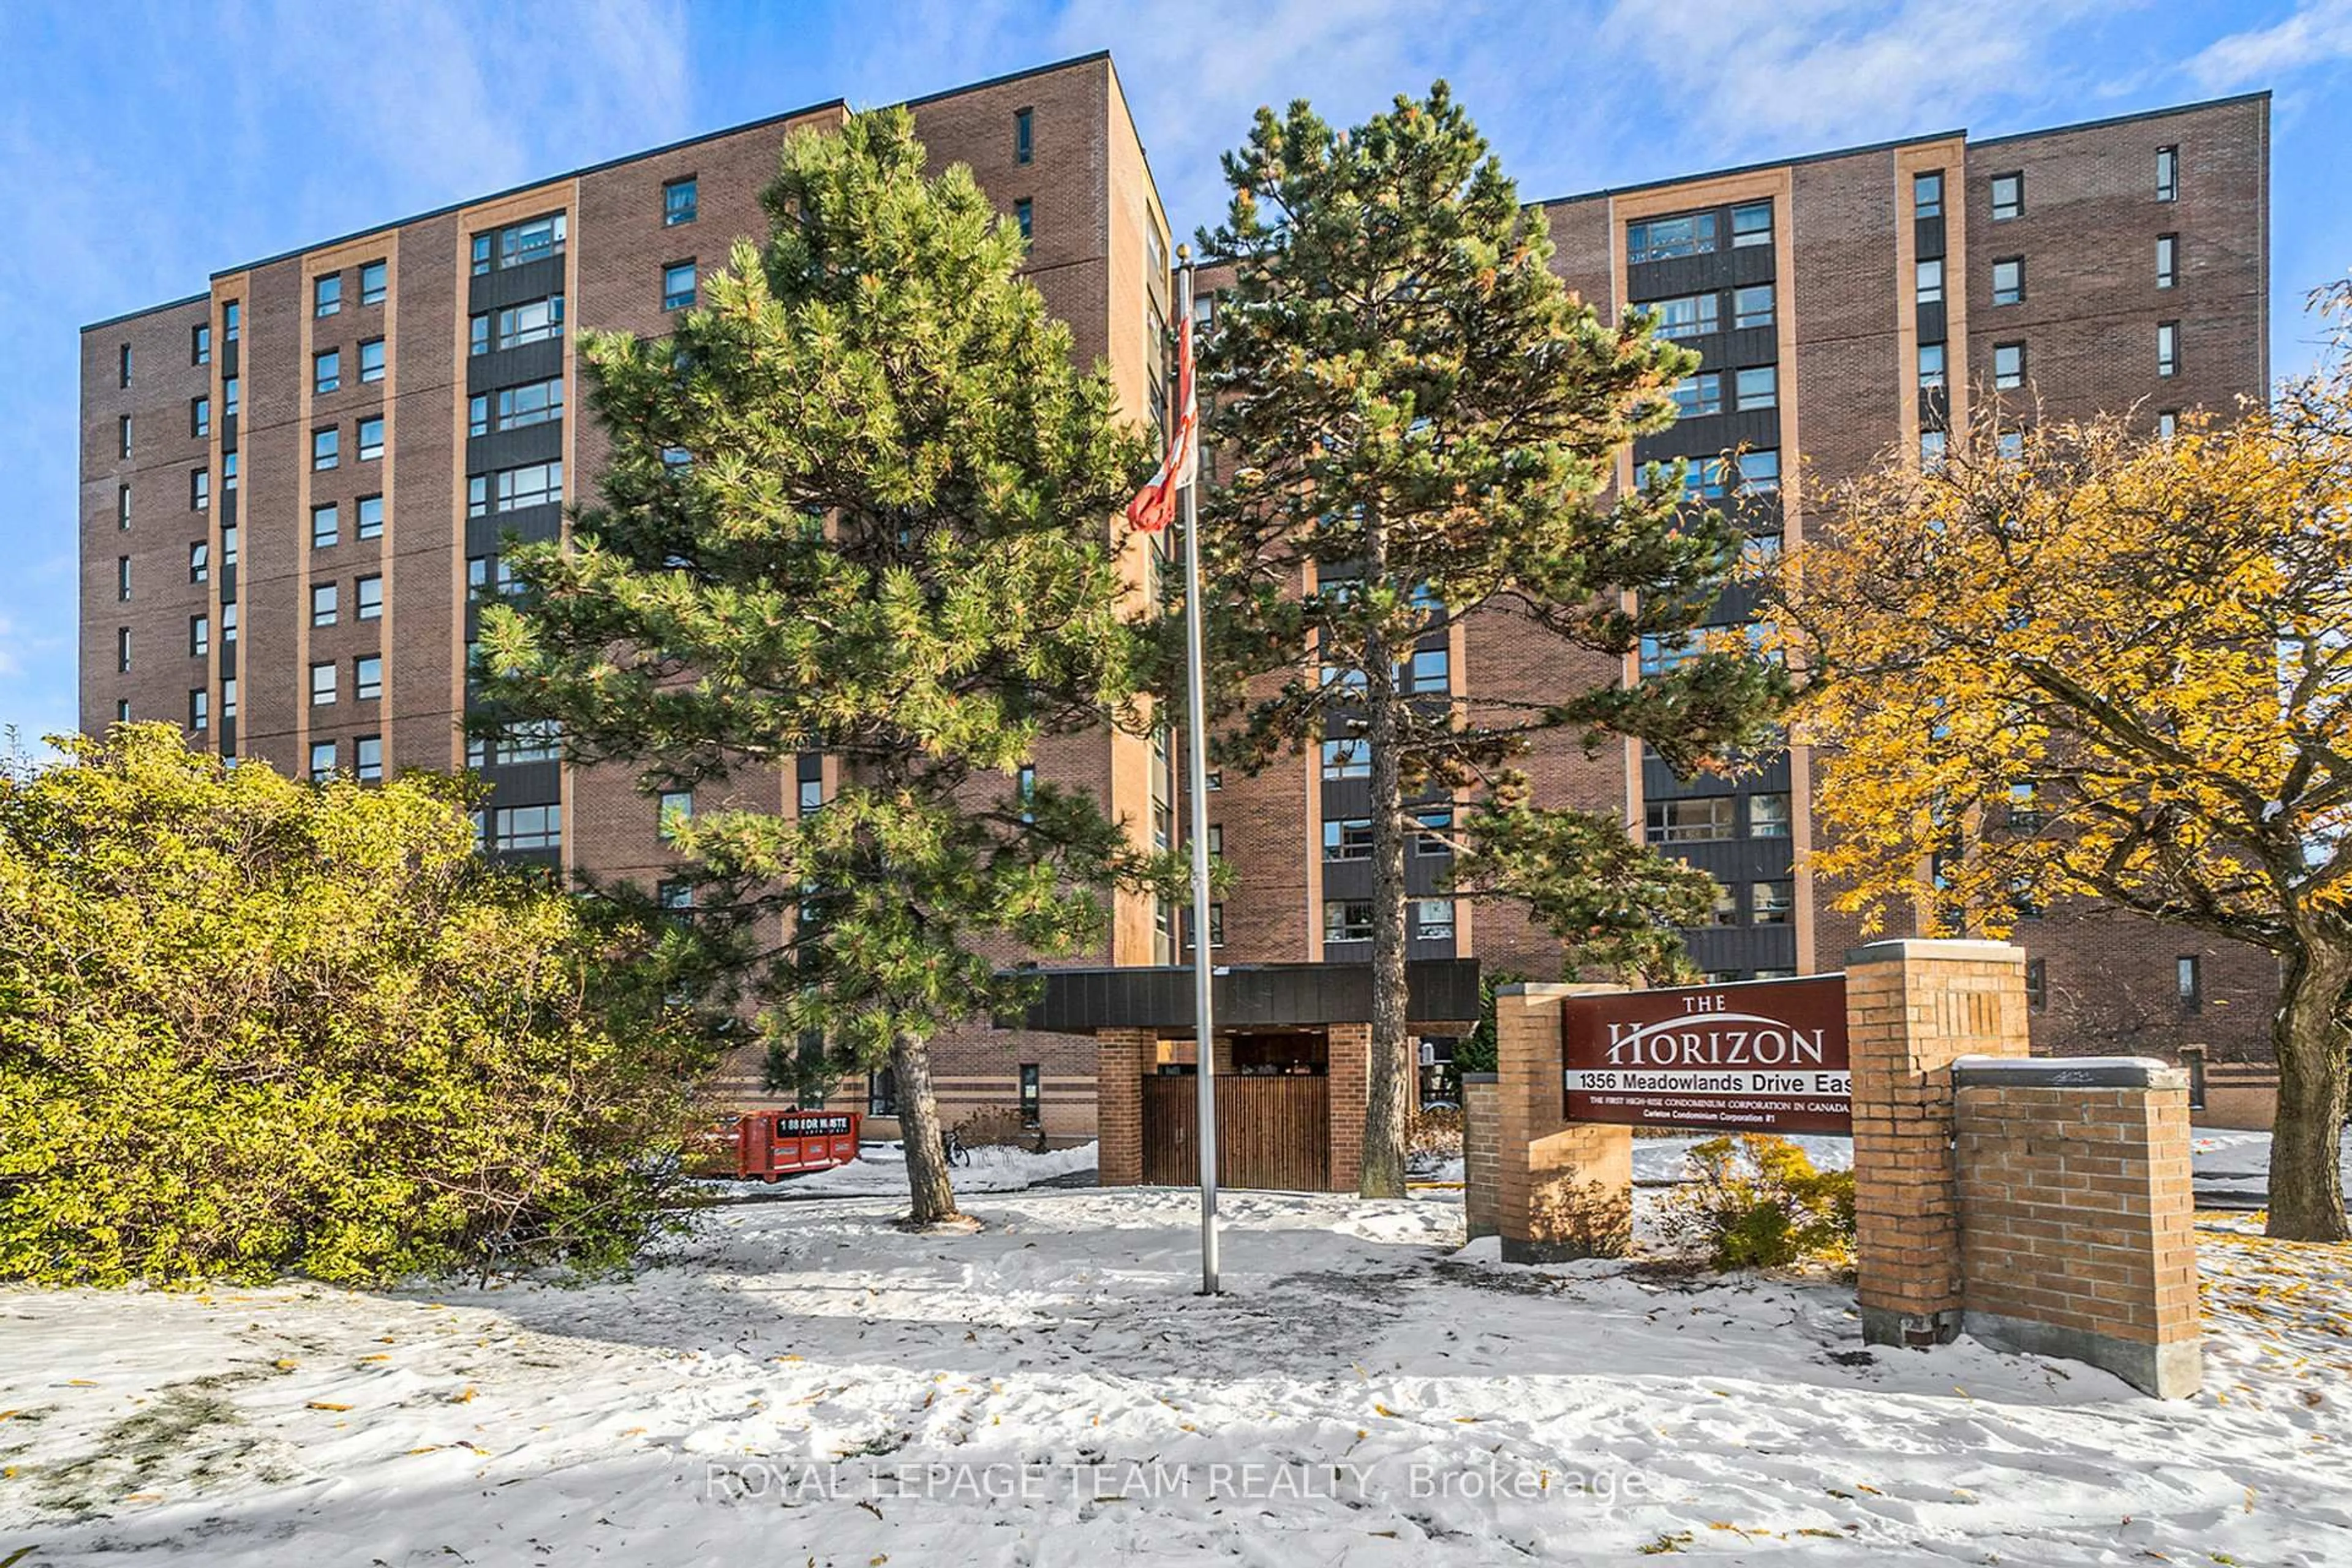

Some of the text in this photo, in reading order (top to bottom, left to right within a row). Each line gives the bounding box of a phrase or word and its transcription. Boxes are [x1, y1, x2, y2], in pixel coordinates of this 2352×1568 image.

[1683, 995, 1726, 1012] THE
[1605, 1023, 1825, 1065] HORIZON
[1580, 1073, 1852, 1093] 1356 Meadowlands Drive Eas
[1589, 1096, 1604, 1104] THE
[1605, 1096, 1624, 1105] FIRST
[1665, 1098, 1725, 1109] CONDOMINIUM
[1728, 1100, 1792, 1111] CORPORATION
[1793, 1102, 1805, 1111] IN
[1807, 1102, 1850, 1113] CANADA
[1672, 1109, 1717, 1120] Condominium
[1719, 1112, 1763, 1123] Corporation
